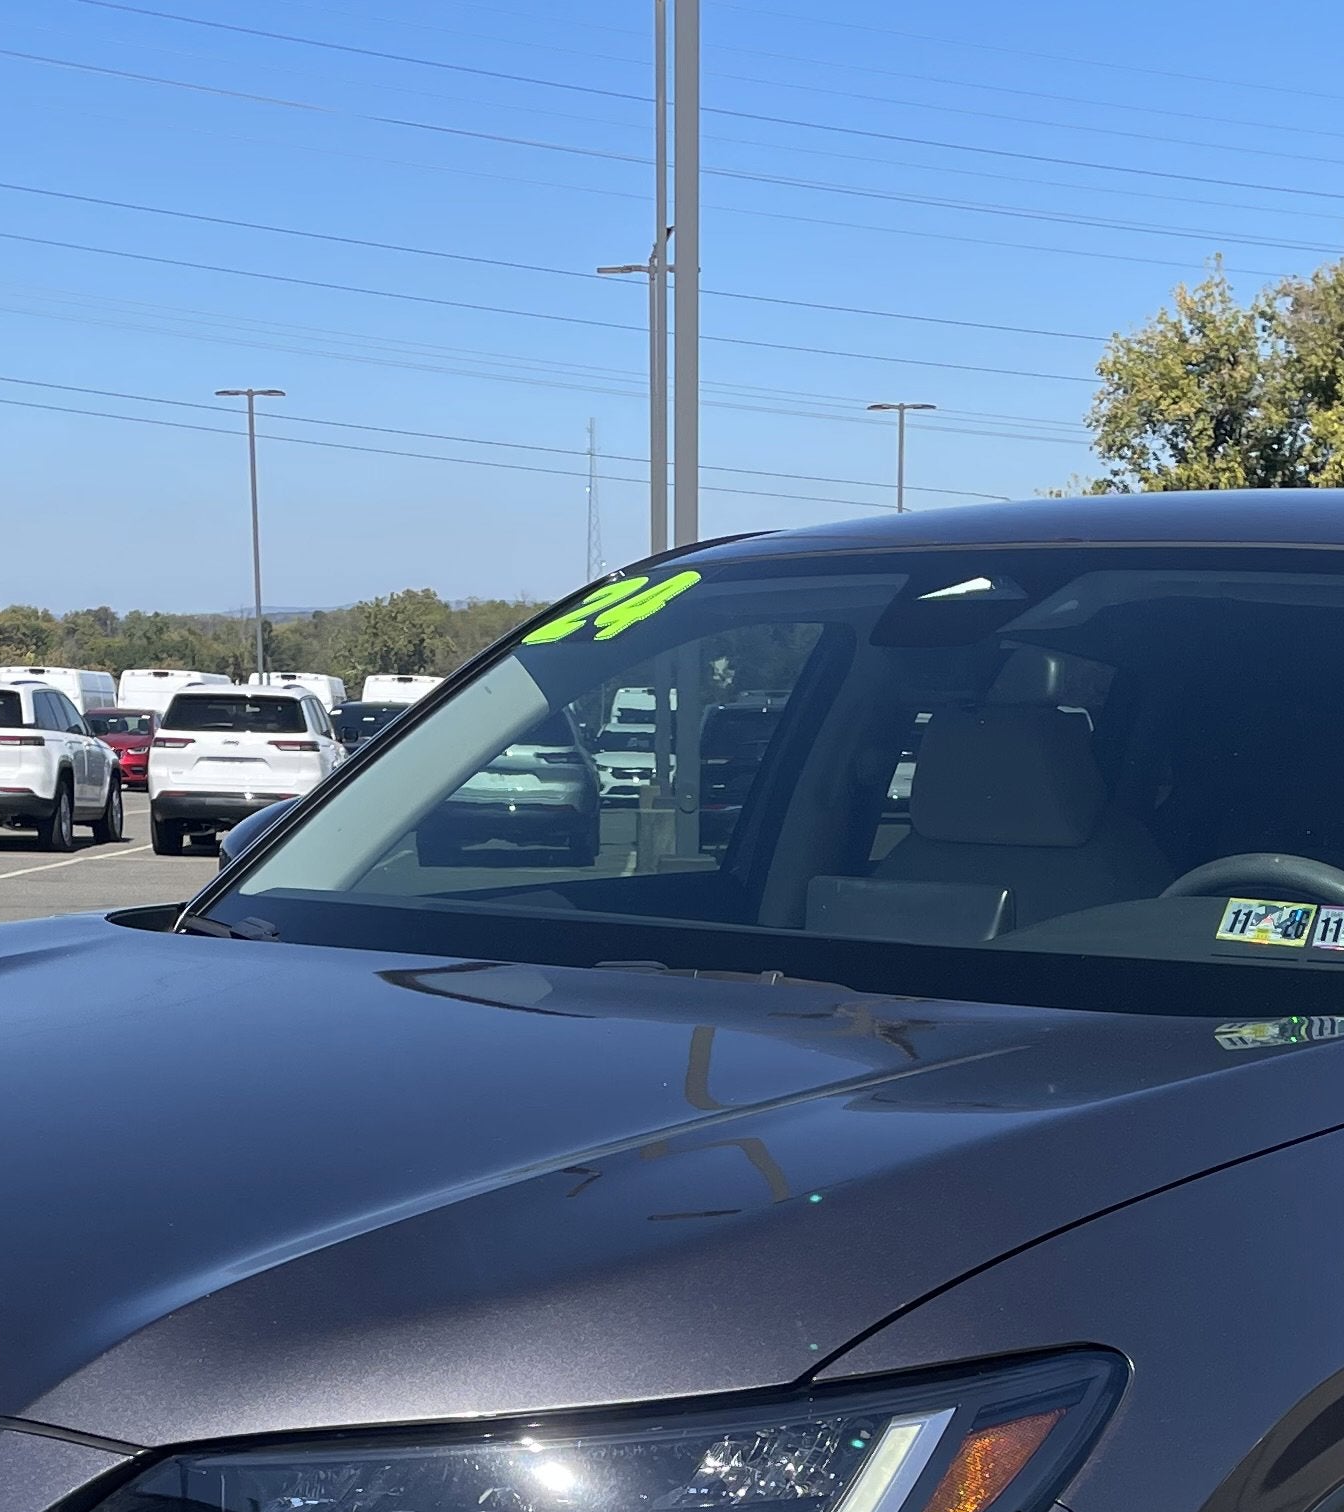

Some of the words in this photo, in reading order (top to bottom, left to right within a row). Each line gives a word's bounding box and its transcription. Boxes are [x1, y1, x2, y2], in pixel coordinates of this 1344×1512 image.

[522, 571, 702, 645] 24
[1228, 908, 1254, 934] 11
[1320, 916, 1344, 943] 11
